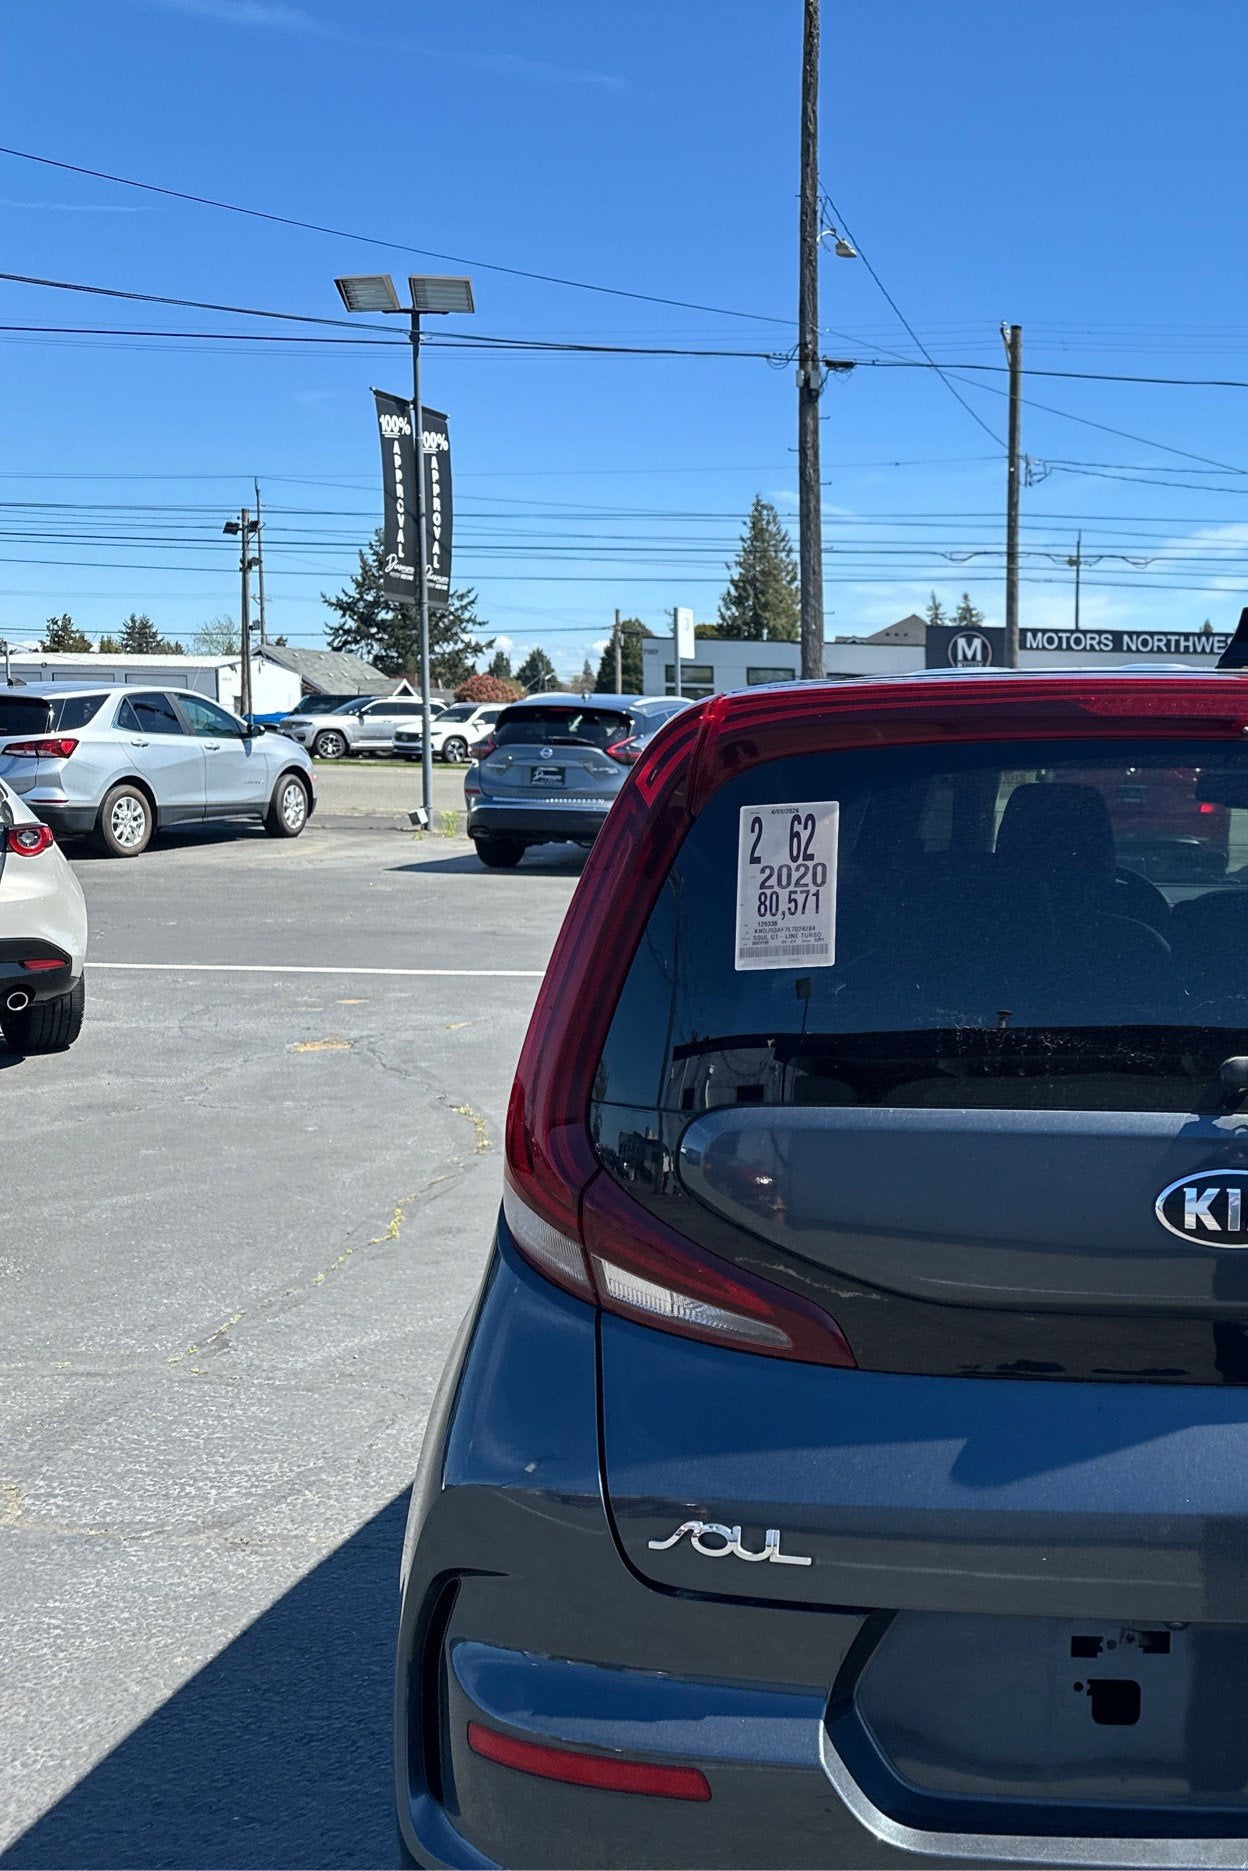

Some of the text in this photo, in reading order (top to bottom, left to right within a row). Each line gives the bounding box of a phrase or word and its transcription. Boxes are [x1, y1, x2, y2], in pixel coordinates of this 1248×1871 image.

[380, 414, 411, 435] 100%
[422, 431, 449, 451] 00%
[392, 440, 404, 558] APPROVAL
[430, 456, 441, 569] APPROVAL
[957, 637, 982, 661] M
[1025, 631, 1113, 650] MOTORS
[749, 813, 816, 864] 2 62
[759, 862, 827, 890] 2020
[757, 889, 820, 921] 80,571
[648, 1520, 812, 1566] SOUL
